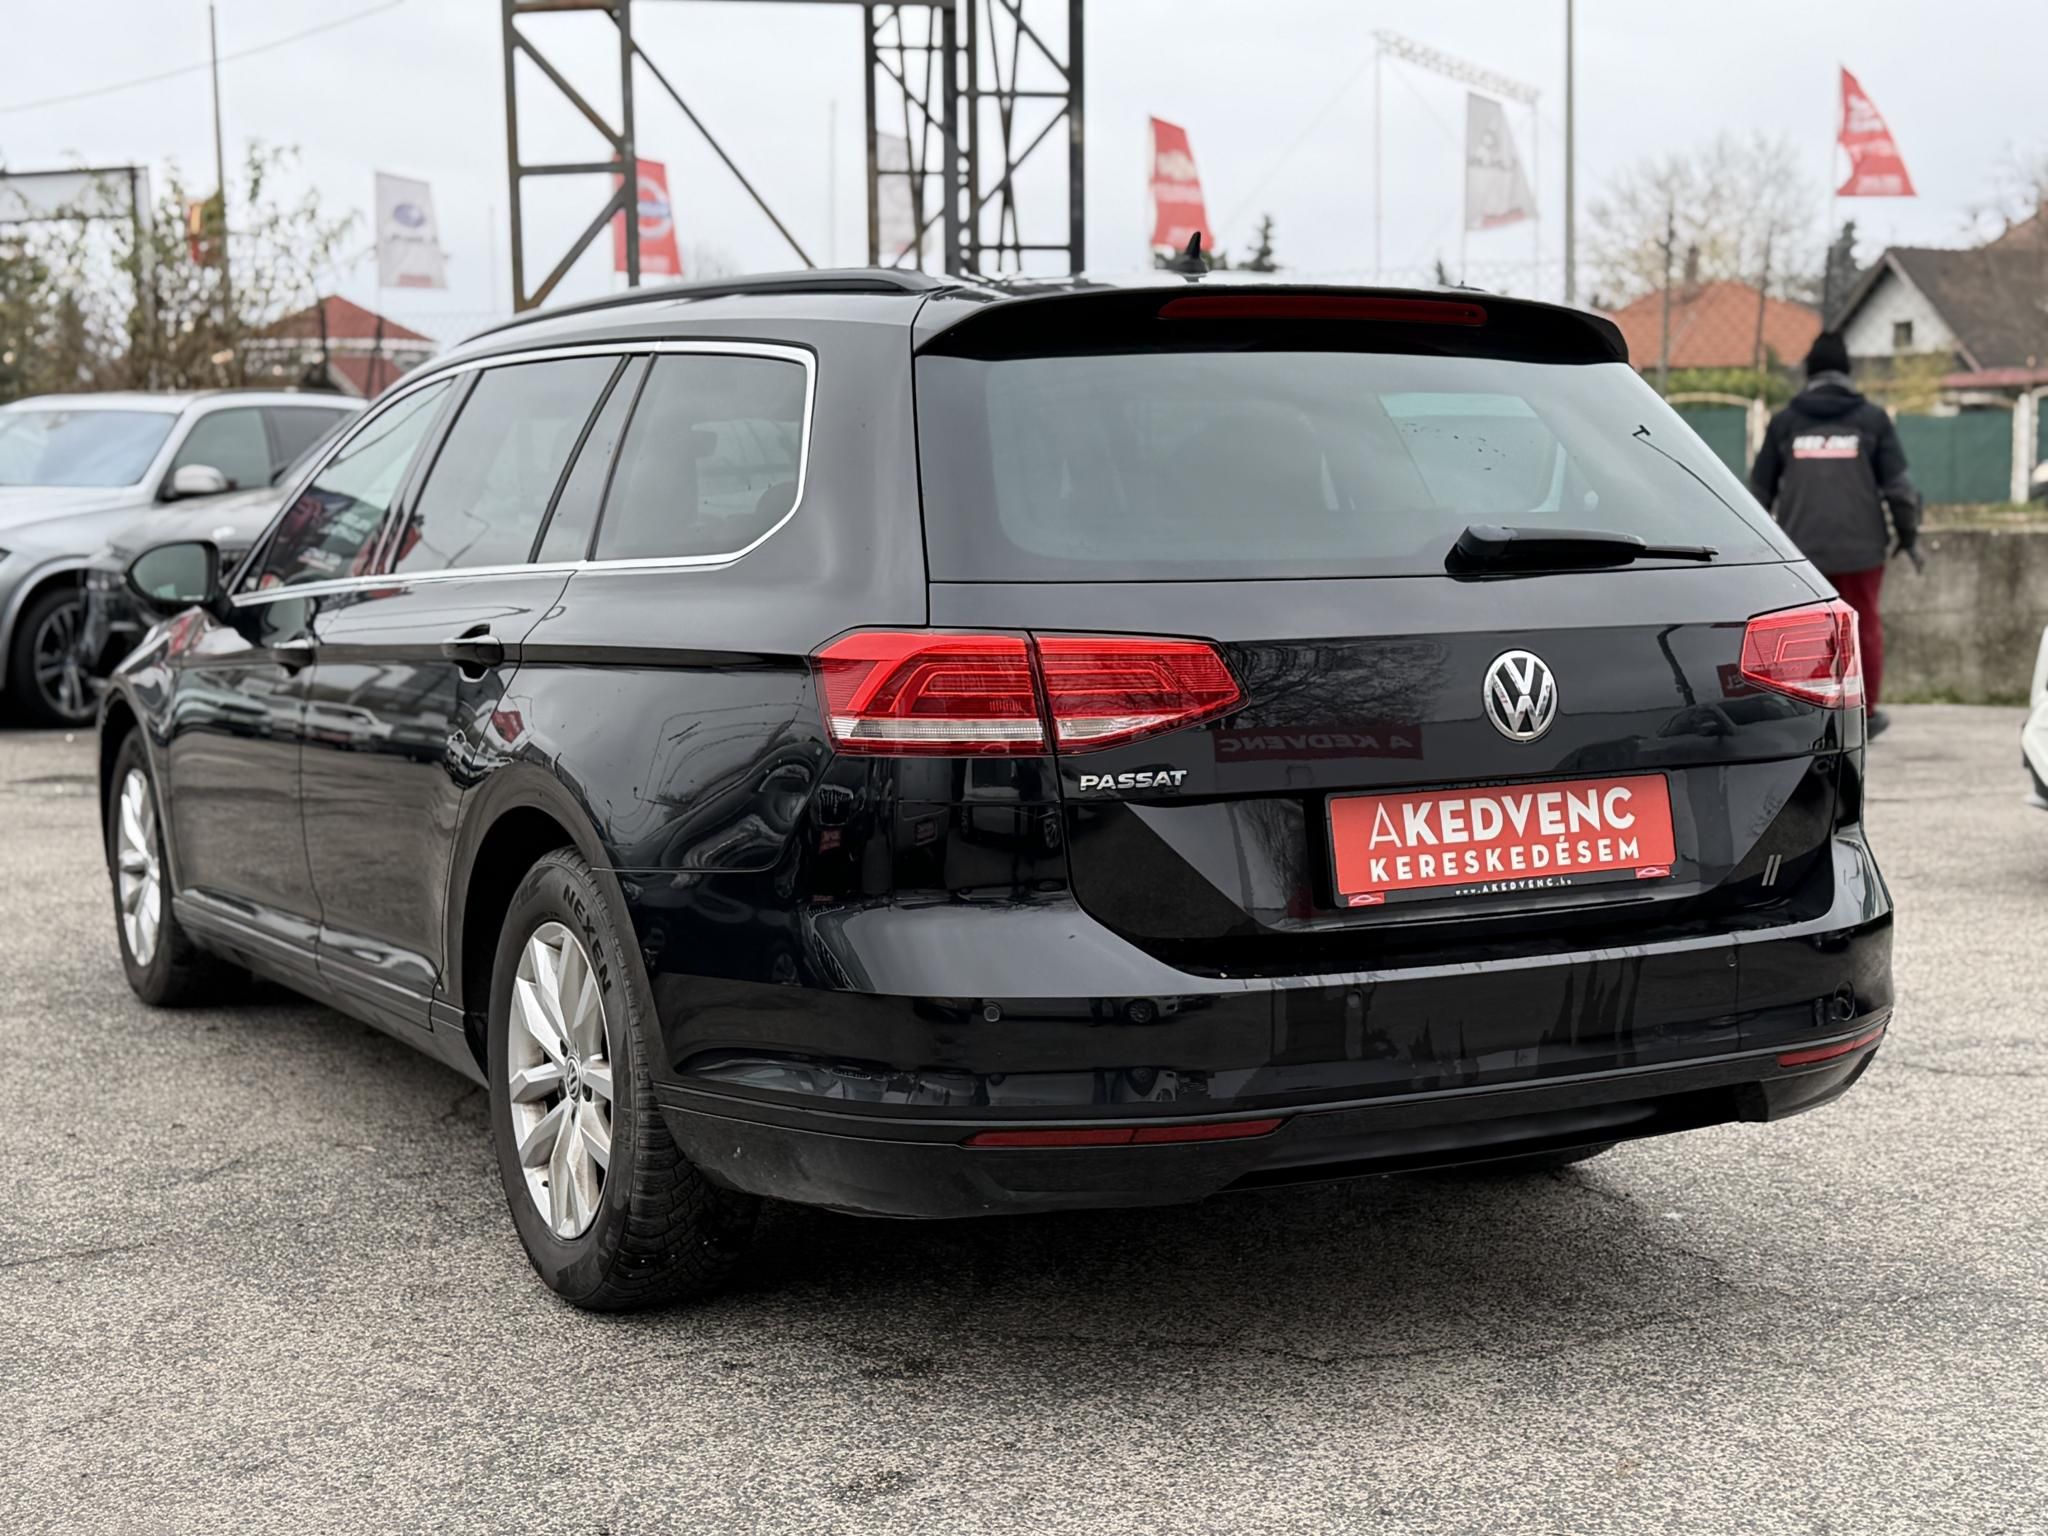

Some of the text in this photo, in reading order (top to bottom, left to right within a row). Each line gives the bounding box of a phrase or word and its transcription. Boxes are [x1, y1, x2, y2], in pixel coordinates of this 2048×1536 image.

[1080, 770, 1187, 791] PASSAT
[1369, 832, 1640, 883] KERESKEDÉSEM
[563, 884, 612, 994] NEXEN
